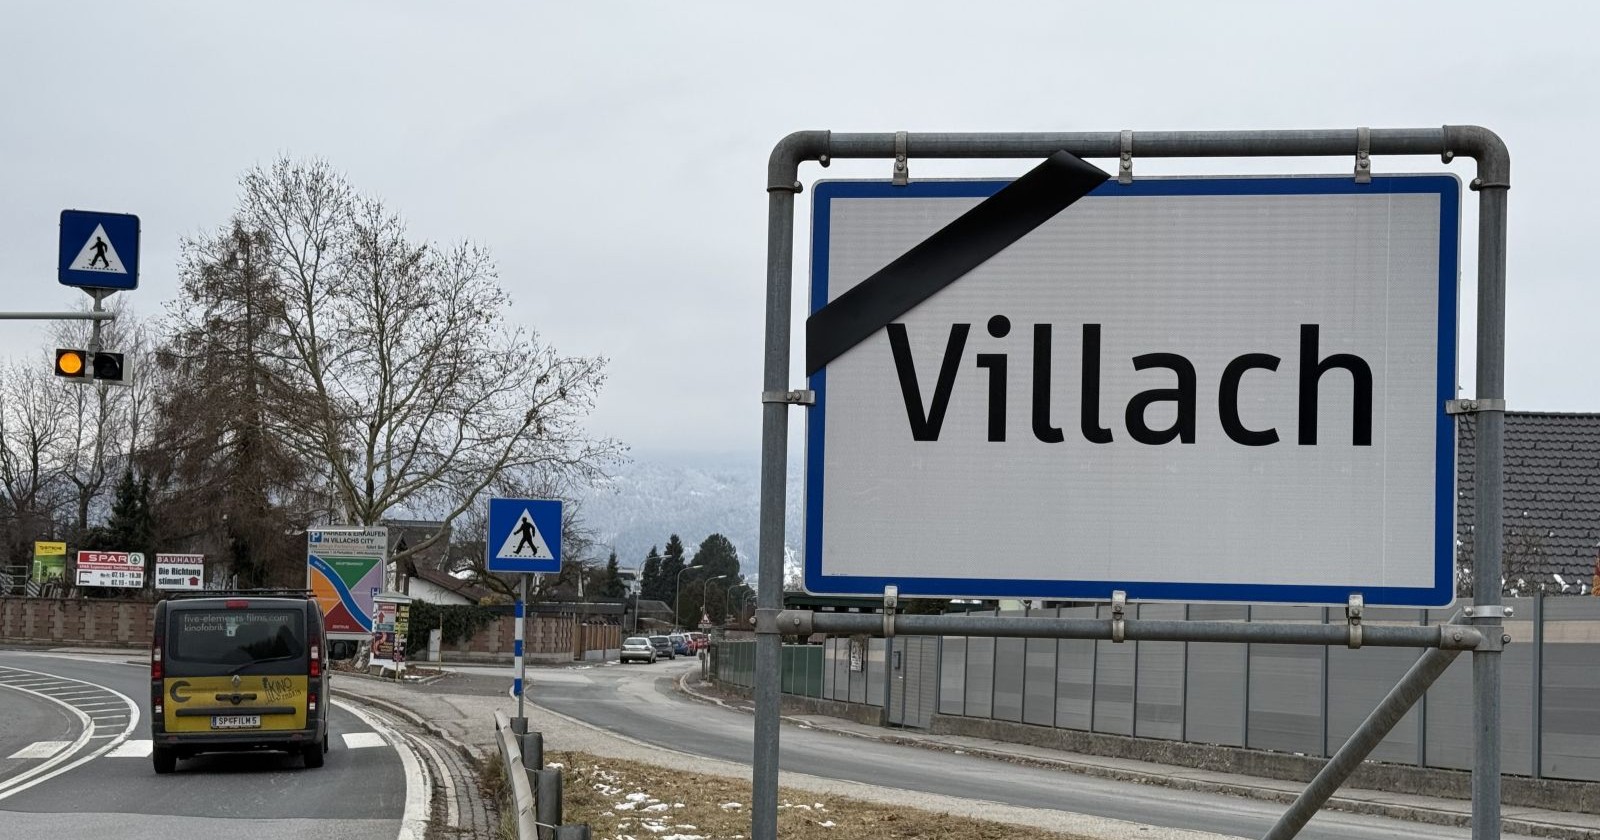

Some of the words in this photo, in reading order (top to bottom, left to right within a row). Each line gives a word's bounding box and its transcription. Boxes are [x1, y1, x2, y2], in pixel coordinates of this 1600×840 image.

[886, 315, 1374, 446] Villach
[88, 554, 127, 563] SPAR
[158, 567, 170, 575] Die
[171, 567, 201, 577] Richtung
[158, 577, 185, 586] stimmt!
